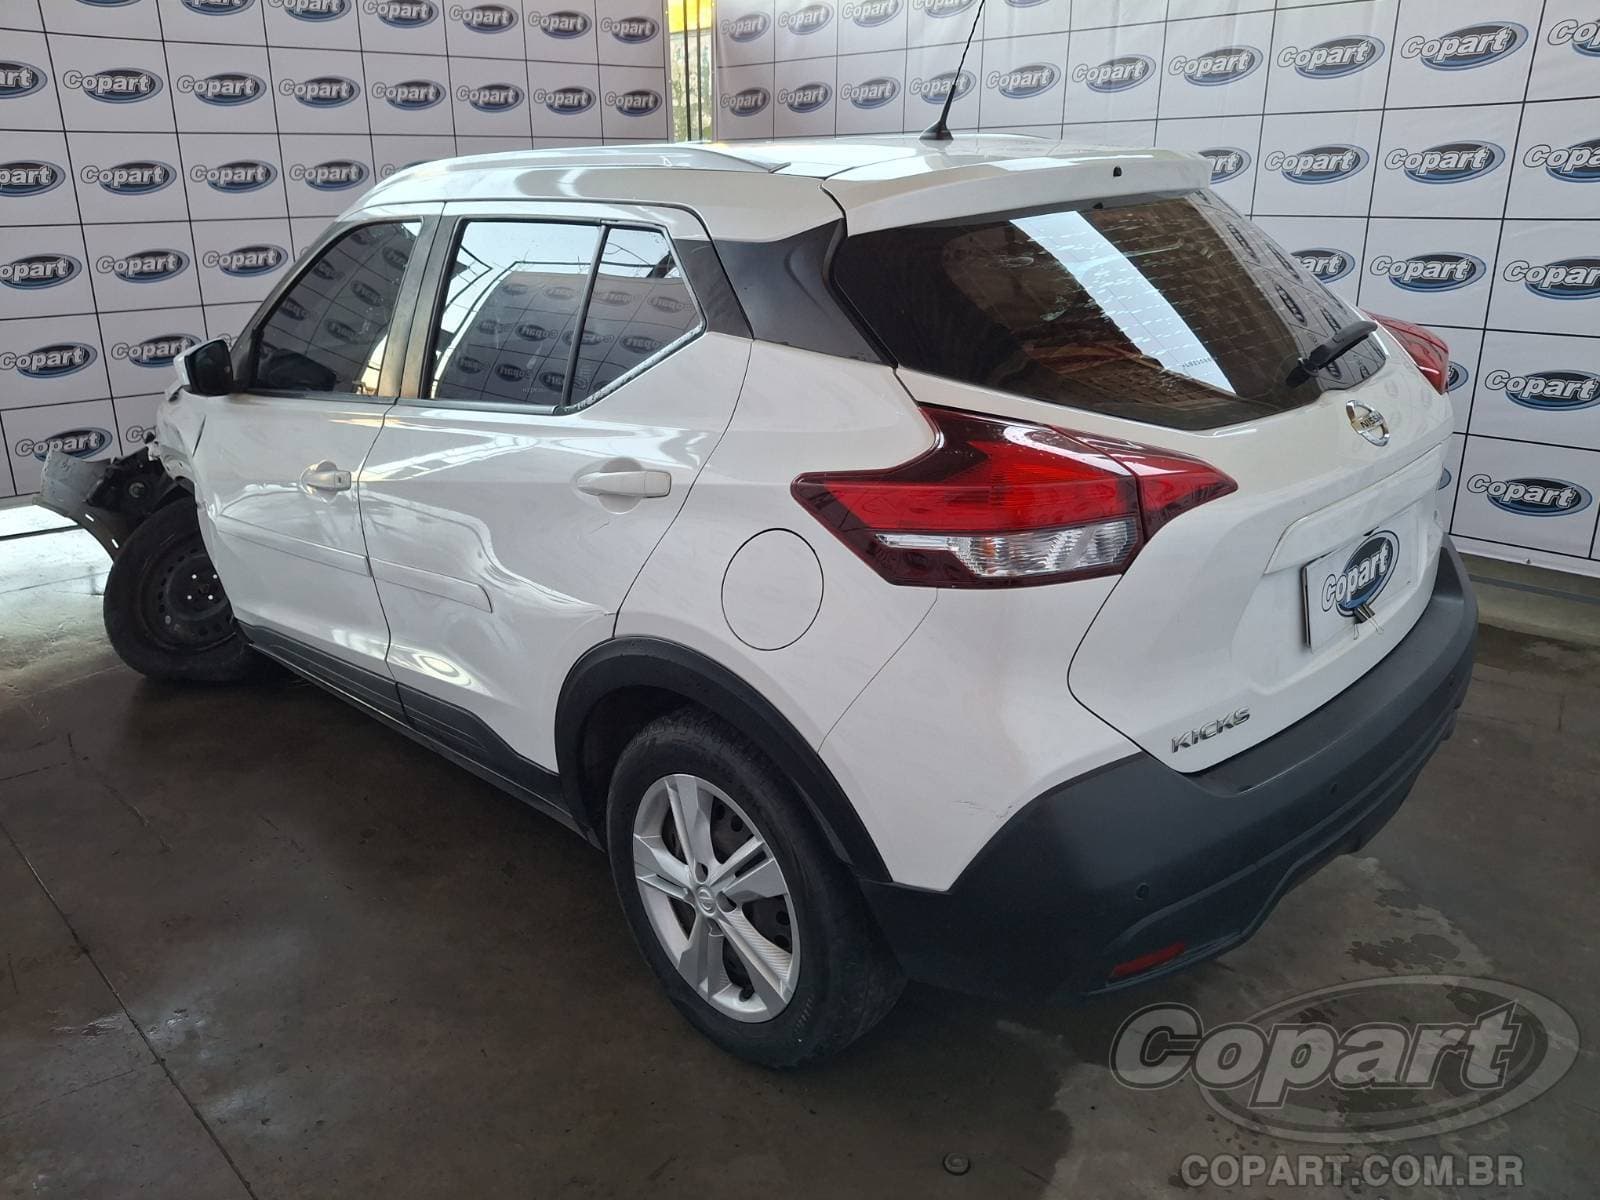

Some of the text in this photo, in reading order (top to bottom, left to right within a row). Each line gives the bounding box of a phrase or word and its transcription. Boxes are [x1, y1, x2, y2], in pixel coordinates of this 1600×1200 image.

[450, 5, 509, 25] Copart
[528, 13, 586, 33] Copart
[601, 17, 653, 36] Copart
[720, 15, 764, 36] Copart
[778, 5, 827, 29] Copart
[1277, 40, 1372, 72] Copart
[1400, 25, 1512, 63] Copart
[1072, 58, 1147, 86] Copart
[1168, 50, 1251, 78] Copart
[64, 69, 152, 94] Copart
[177, 75, 256, 98] Copart
[279, 78, 350, 101] Copart
[841, 79, 895, 101] Copart
[986, 65, 1053, 93] Copart
[371, 82, 439, 103] Copart
[456, 85, 517, 106] Copart
[534, 88, 590, 107] Copart
[605, 92, 656, 109] Copart
[720, 90, 765, 110] Copart
[777, 84, 829, 106] Copart
[1265, 150, 1357, 175] Copart
[1385, 145, 1489, 176] Copart
[80, 163, 166, 188] Copart
[190, 163, 269, 187] Copart
[289, 162, 361, 185] Copart
[0, 257, 69, 283] opart
[96, 250, 180, 274] Copart
[203, 248, 280, 271] Copart
[1370, 255, 1473, 280] Copart
[1503, 260, 1600, 288] Copar
[0, 344, 86, 371] Copart
[1485, 370, 1599, 400] Copart
[15, 431, 98, 457] Copart
[1467, 474, 1580, 508] Copart
[1321, 537, 1389, 612] Copart
[1171, 705, 1250, 754] KICKS
